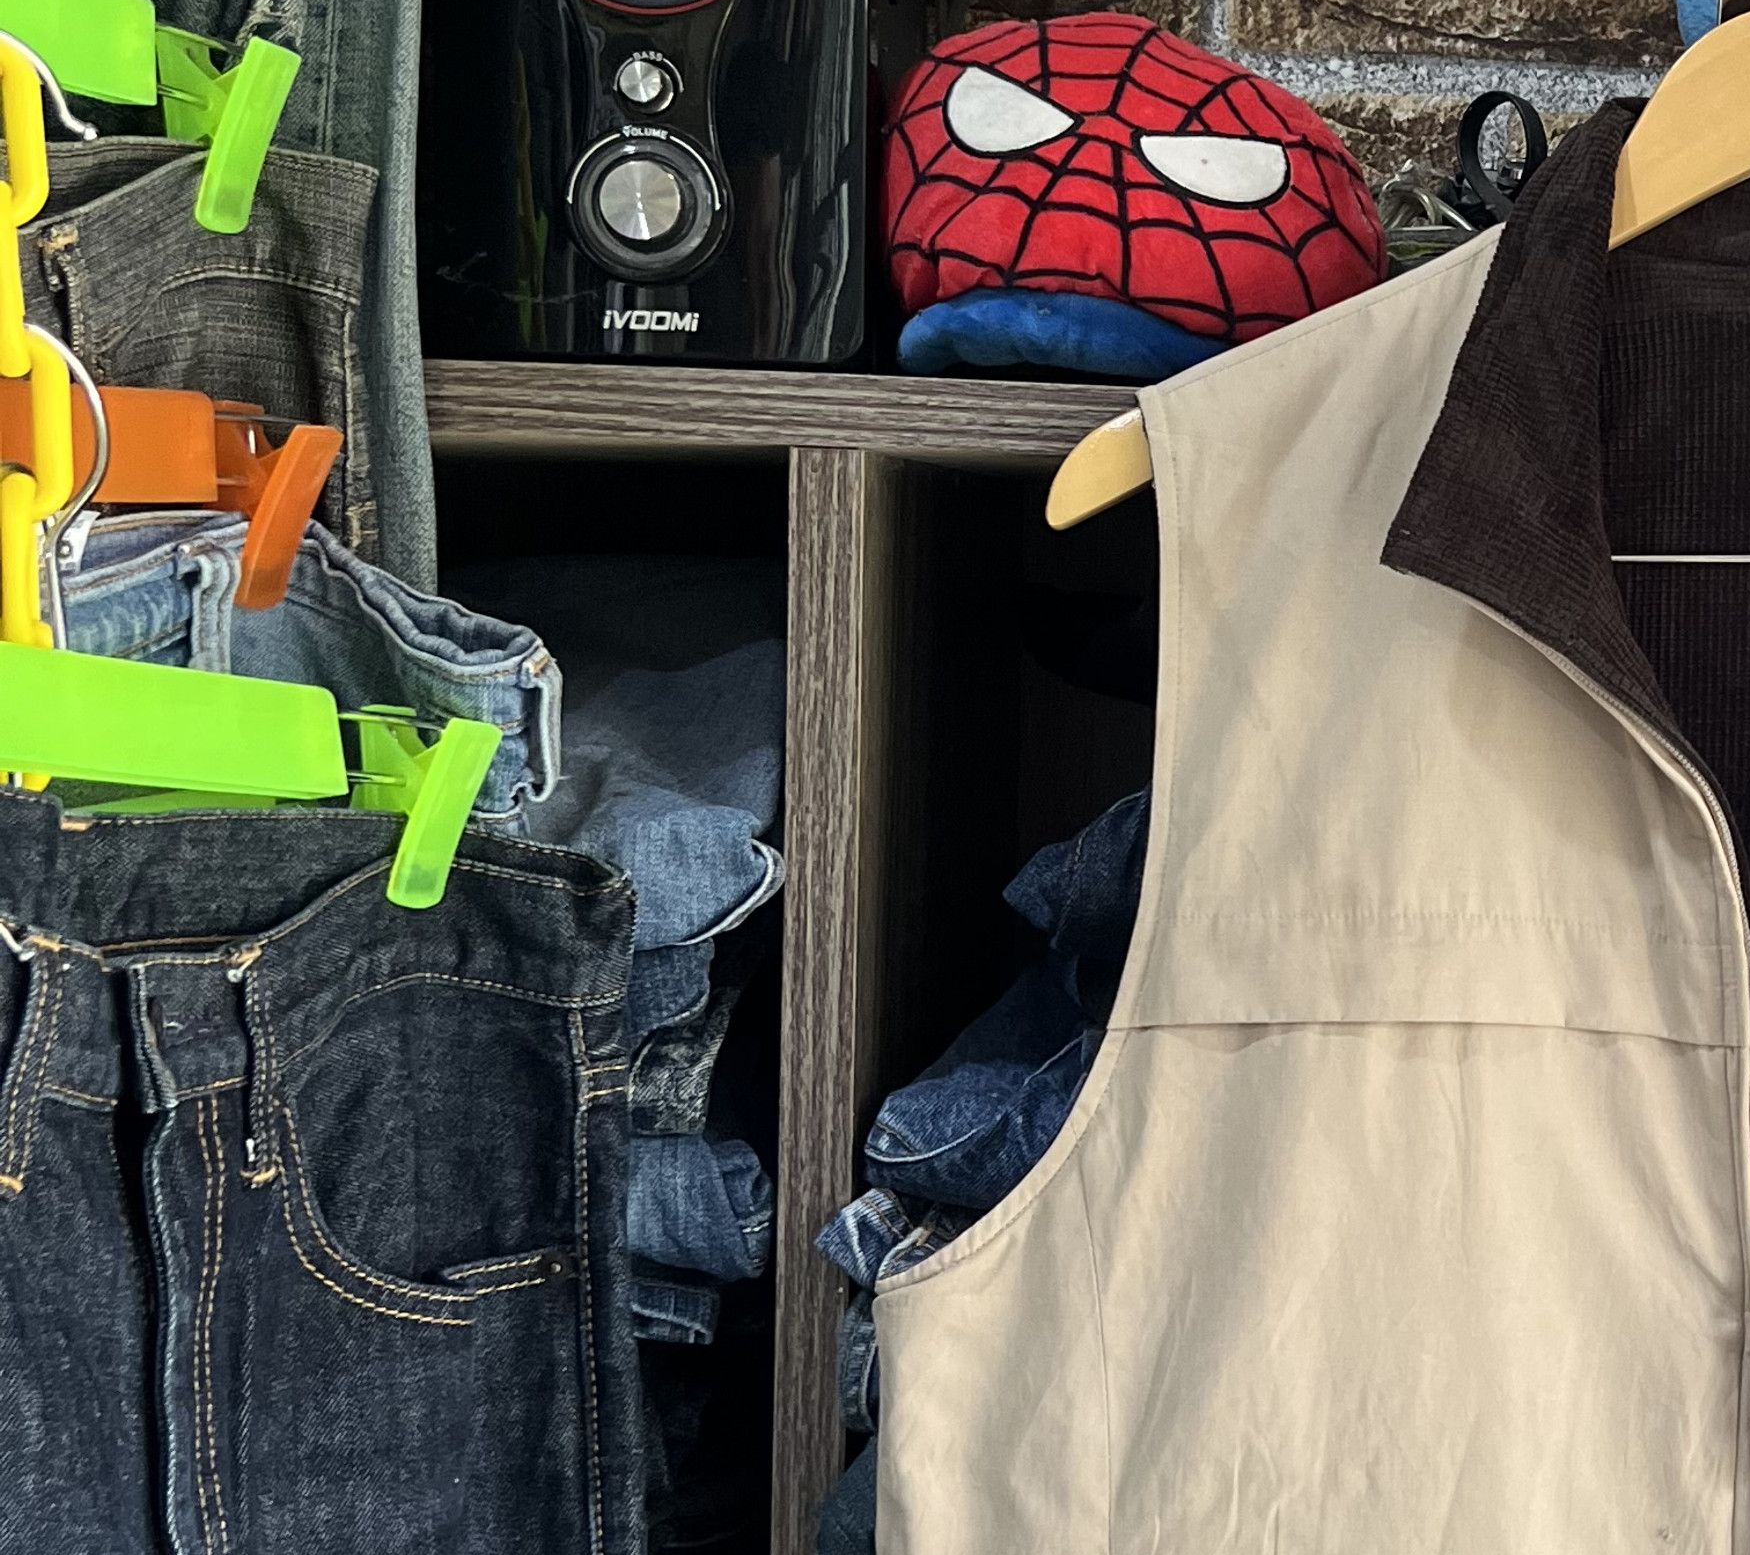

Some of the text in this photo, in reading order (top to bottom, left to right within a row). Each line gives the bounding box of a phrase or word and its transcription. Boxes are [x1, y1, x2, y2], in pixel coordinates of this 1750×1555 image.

[633, 51, 663, 61] BASS
[622, 125, 668, 140] VOLUME
[603, 310, 699, 332] iVOOMi
